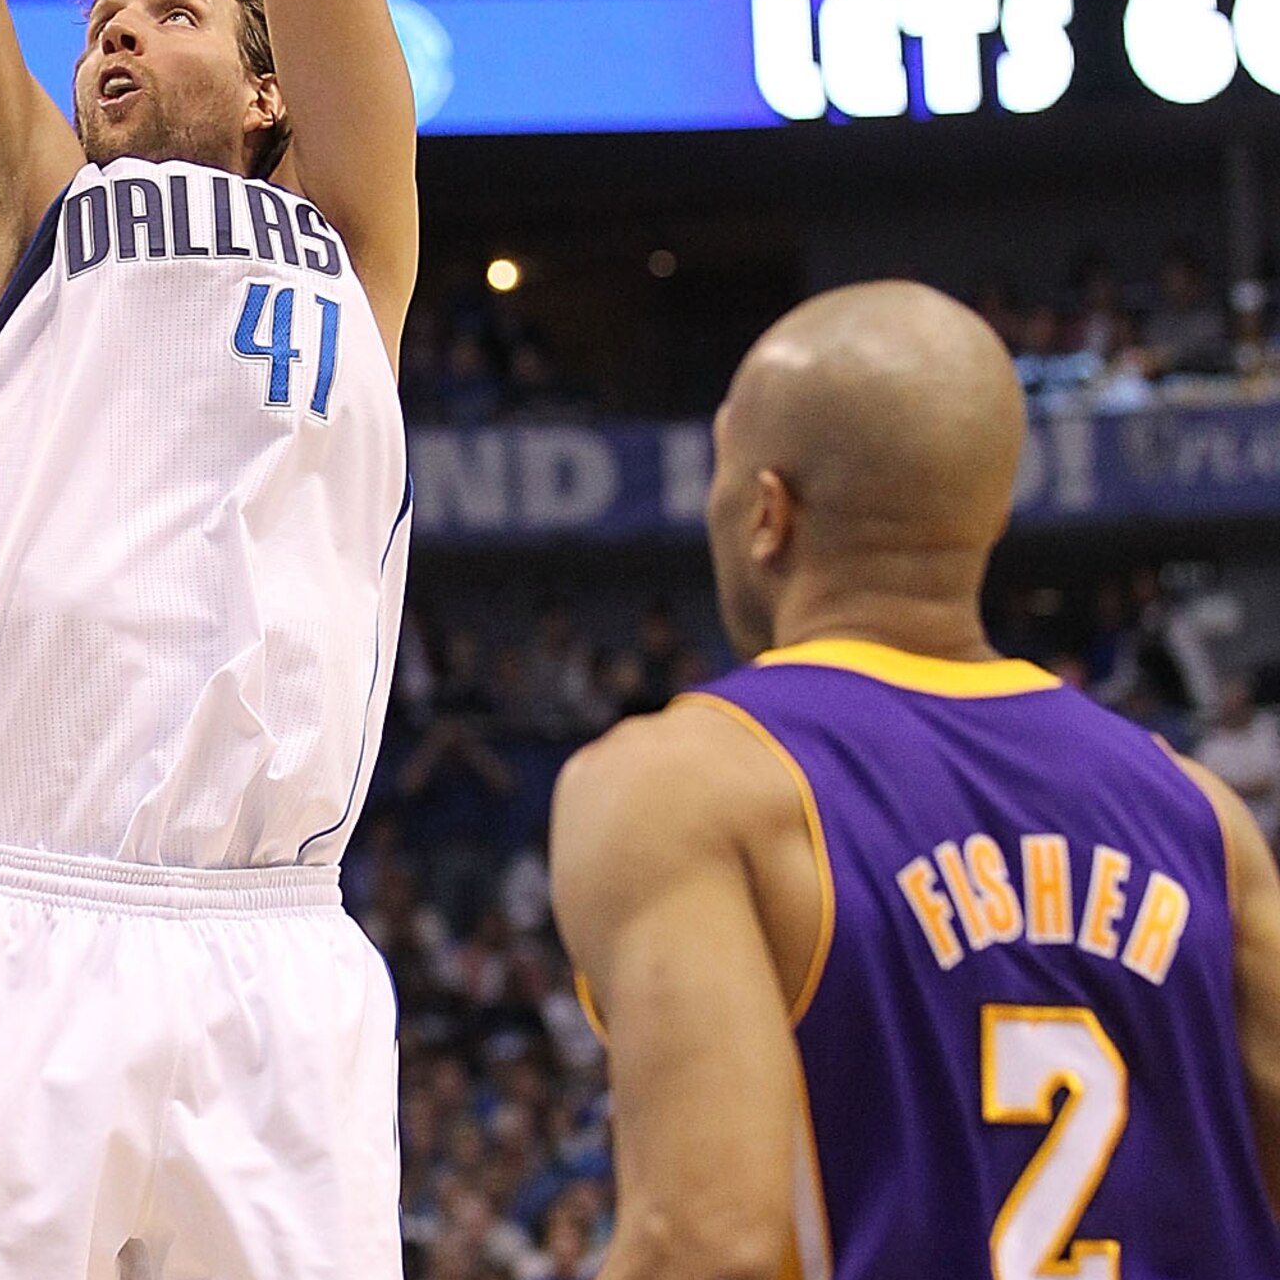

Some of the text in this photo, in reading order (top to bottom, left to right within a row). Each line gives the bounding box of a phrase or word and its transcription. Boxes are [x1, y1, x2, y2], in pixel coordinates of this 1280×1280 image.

[64, 174, 342, 280] DALLAS
[231, 278, 341, 422] 41
[896, 833, 1190, 986] FISHER
